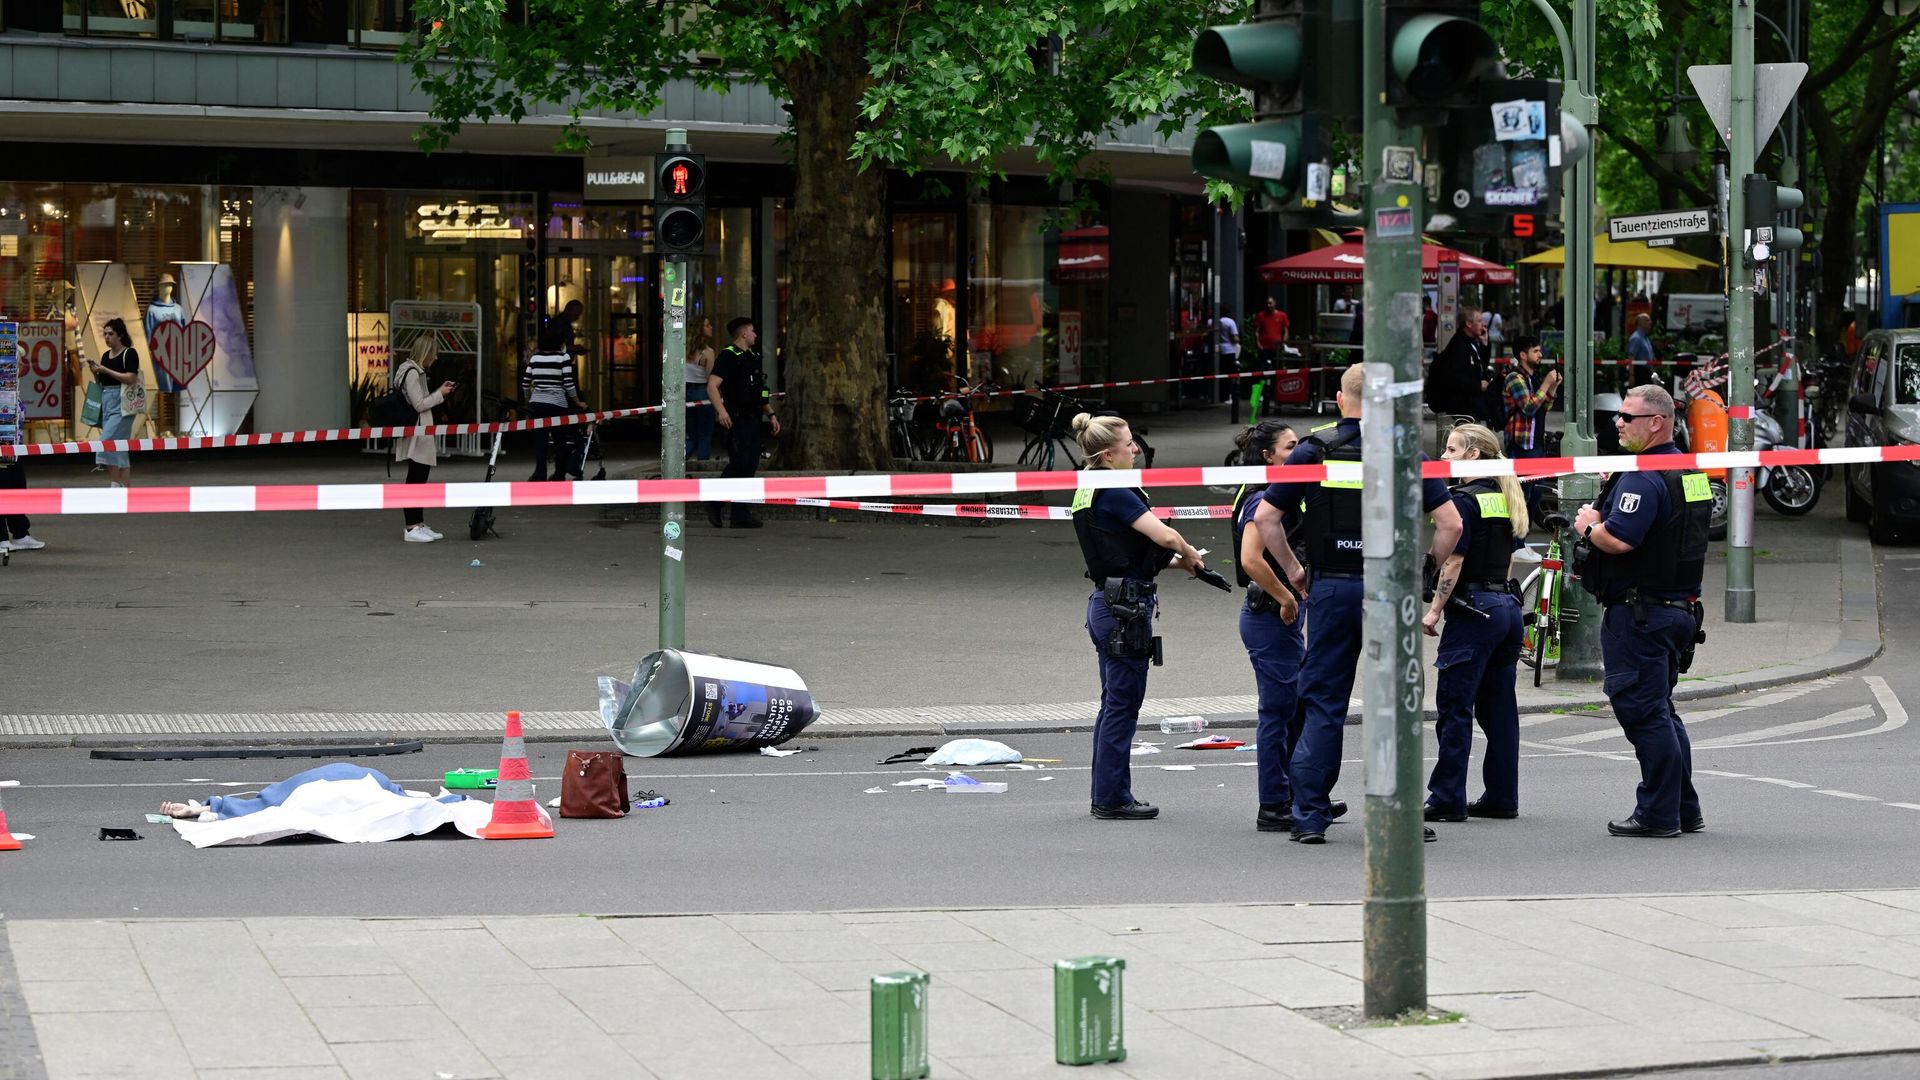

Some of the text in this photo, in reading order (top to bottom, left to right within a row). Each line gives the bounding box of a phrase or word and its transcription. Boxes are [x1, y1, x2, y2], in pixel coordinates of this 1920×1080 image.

[587, 171, 645, 185] PULL&BEAR
[1613, 214, 1706, 233] Tauentzienstraße
[1282, 271, 1331, 280] ORIGINAL
[786, 699, 793, 712] 50
[756, 698, 777, 739] CULTURE
[762, 699, 785, 739] GRAFFITI
